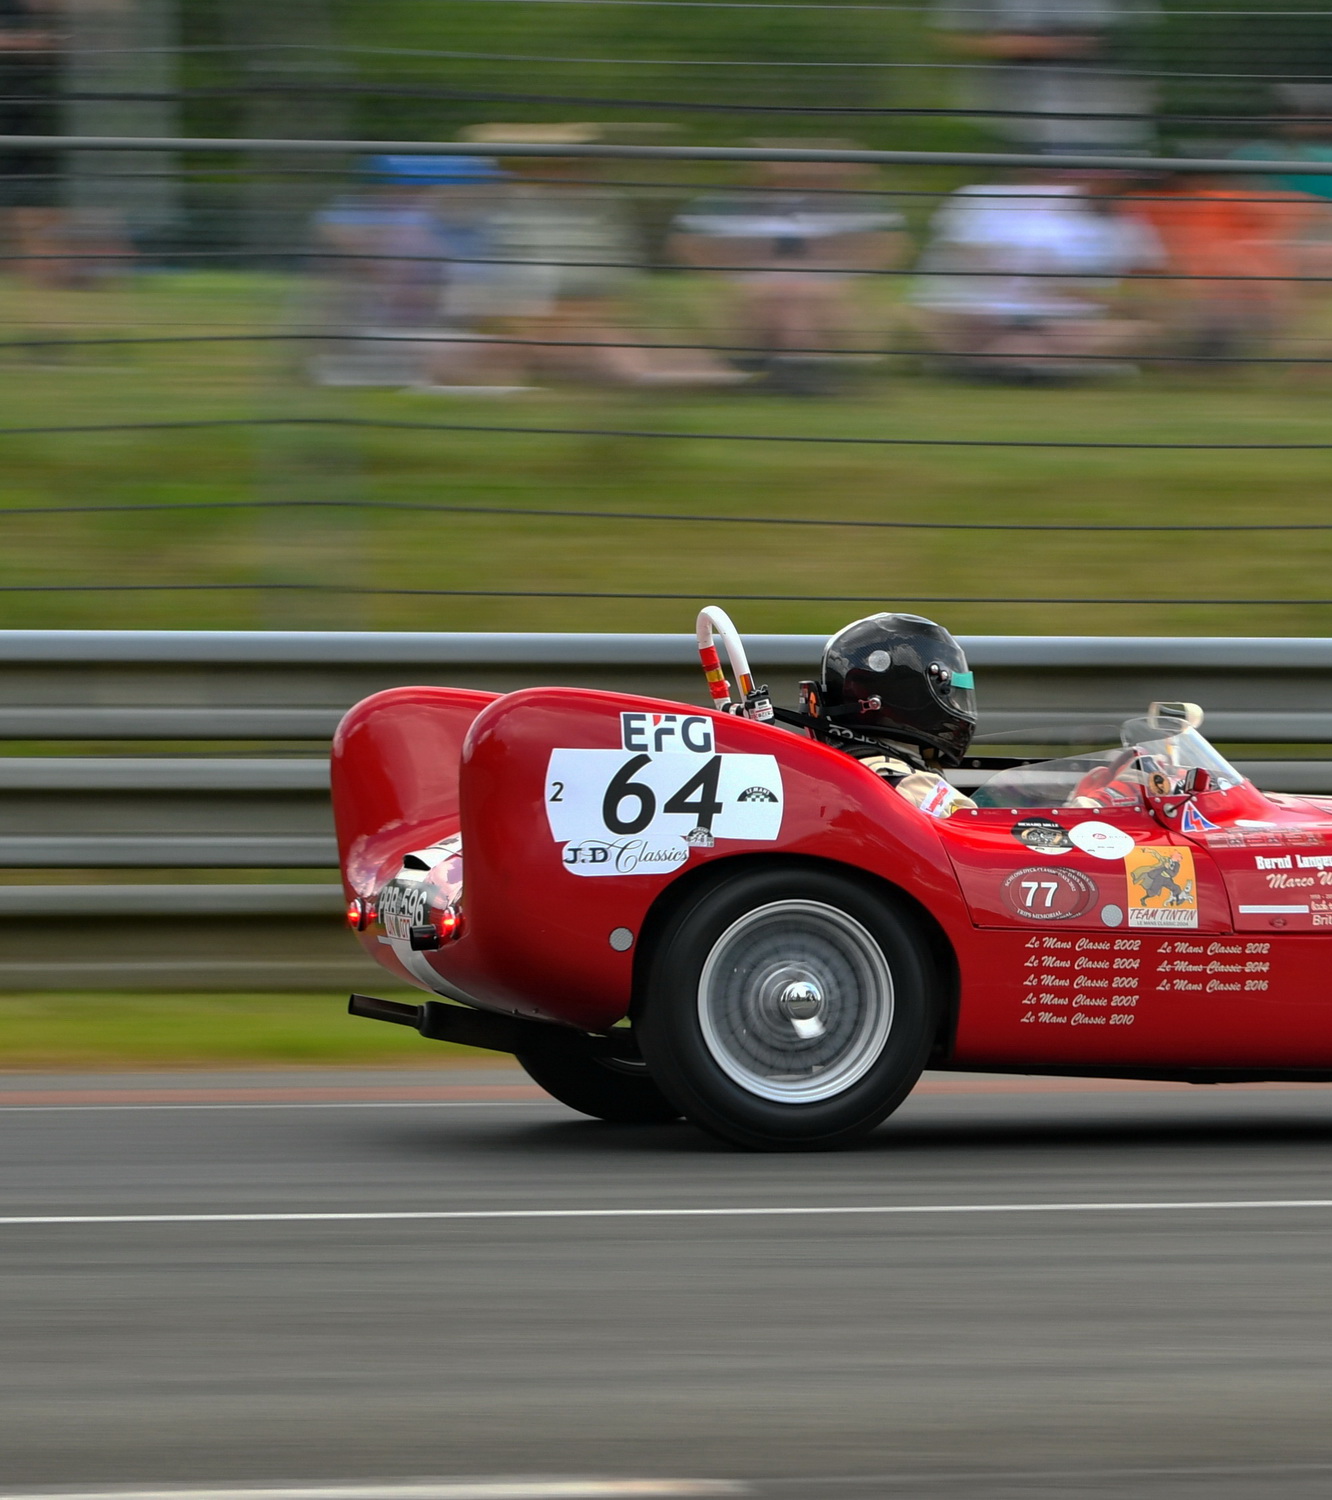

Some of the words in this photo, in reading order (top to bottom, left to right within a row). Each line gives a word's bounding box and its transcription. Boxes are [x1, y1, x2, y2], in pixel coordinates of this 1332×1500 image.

[622, 713, 712, 753] EFG
[549, 781, 565, 802] 2
[602, 753, 723, 835] 64
[611, 838, 688, 873] Classics
[1254, 854, 1293, 870] Bernd
[1266, 873, 1315, 889] Marco
[1021, 881, 1058, 907] 77
[400, 887, 428, 927] 596
[1130, 908, 1159, 920] TEAM
[1160, 909, 1197, 921] TINTIN
[1025, 936, 1040, 948] Le
[1042, 937, 1072, 949] Mans
[1075, 937, 1110, 951] Classic
[1113, 939, 1141, 951] 2002
[1157, 941, 1172, 953] Le
[1174, 942, 1203, 954] Mans
[1207, 942, 1242, 956] Classic
[1244, 942, 1270, 954] 2012
[1024, 955, 1039, 967] Le
[1041, 955, 1071, 968] Mans
[1074, 956, 1110, 970] Classic
[1112, 958, 1141, 970] 2004
[1023, 974, 1038, 986] Le
[1040, 974, 1070, 986] Mans
[1073, 975, 1109, 989] Classic
[1112, 976, 1139, 988] 2006
[1156, 979, 1171, 991] Le
[1173, 979, 1202, 991] Mans
[1206, 979, 1241, 993] Classic
[1244, 980, 1269, 991] 2016
[1022, 993, 1037, 1005] Le
[1039, 993, 1069, 1005] Mans
[1072, 994, 1108, 1008] Classic
[1110, 995, 1139, 1007] 2008
[1020, 1011, 1036, 1023] Le
[1038, 1011, 1068, 1023] Mans
[1071, 1012, 1106, 1026] Classic
[1109, 1014, 1134, 1025] 2010
